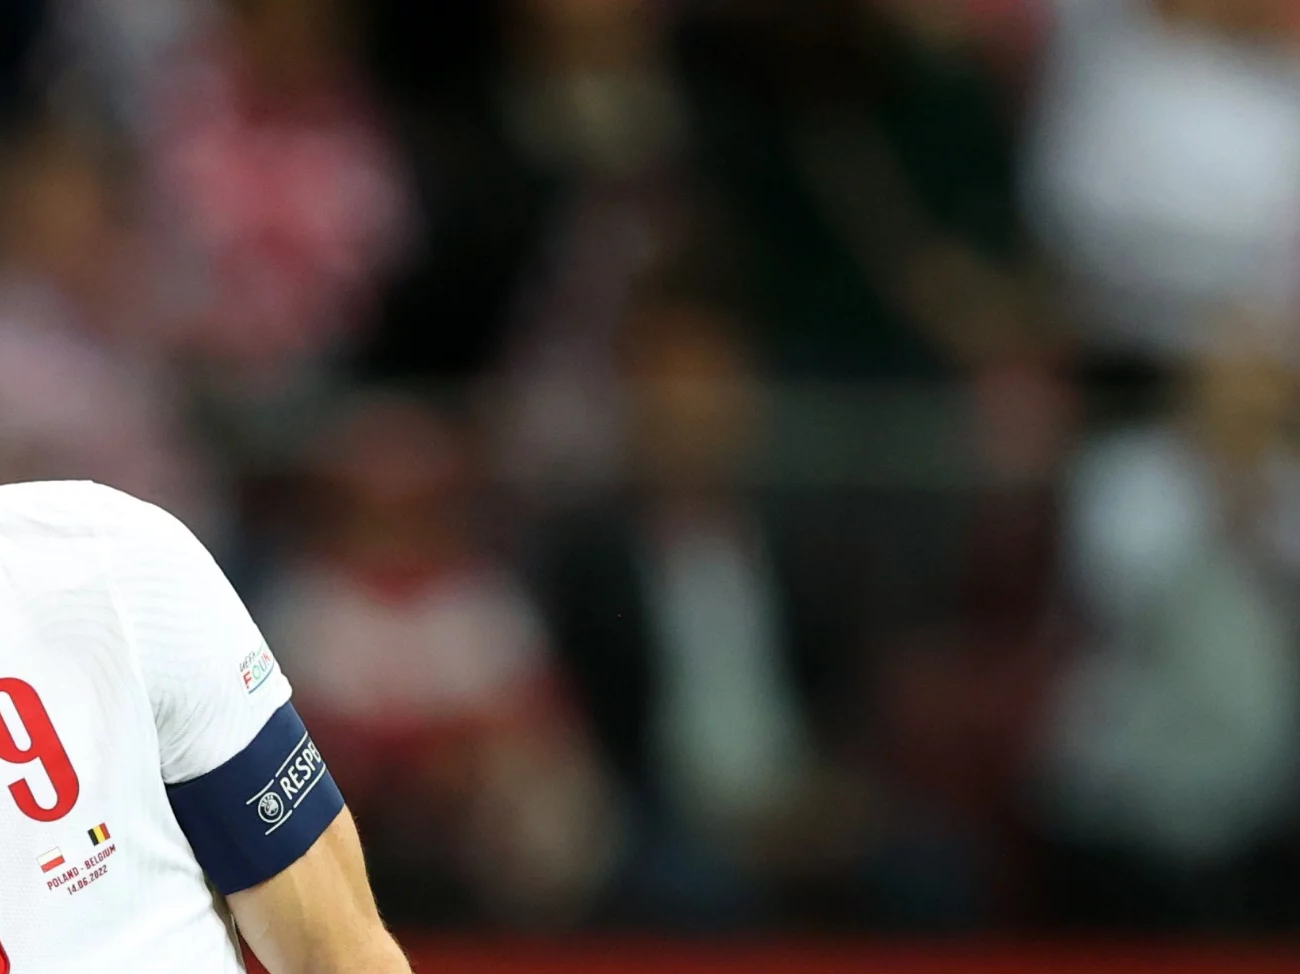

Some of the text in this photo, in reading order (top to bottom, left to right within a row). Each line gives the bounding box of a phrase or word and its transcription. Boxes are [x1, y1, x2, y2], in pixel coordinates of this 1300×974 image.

[47, 866, 80, 891] POLAND
[84, 843, 117, 870] BELGIUM
[67, 864, 109, 896] 14.06.2022
